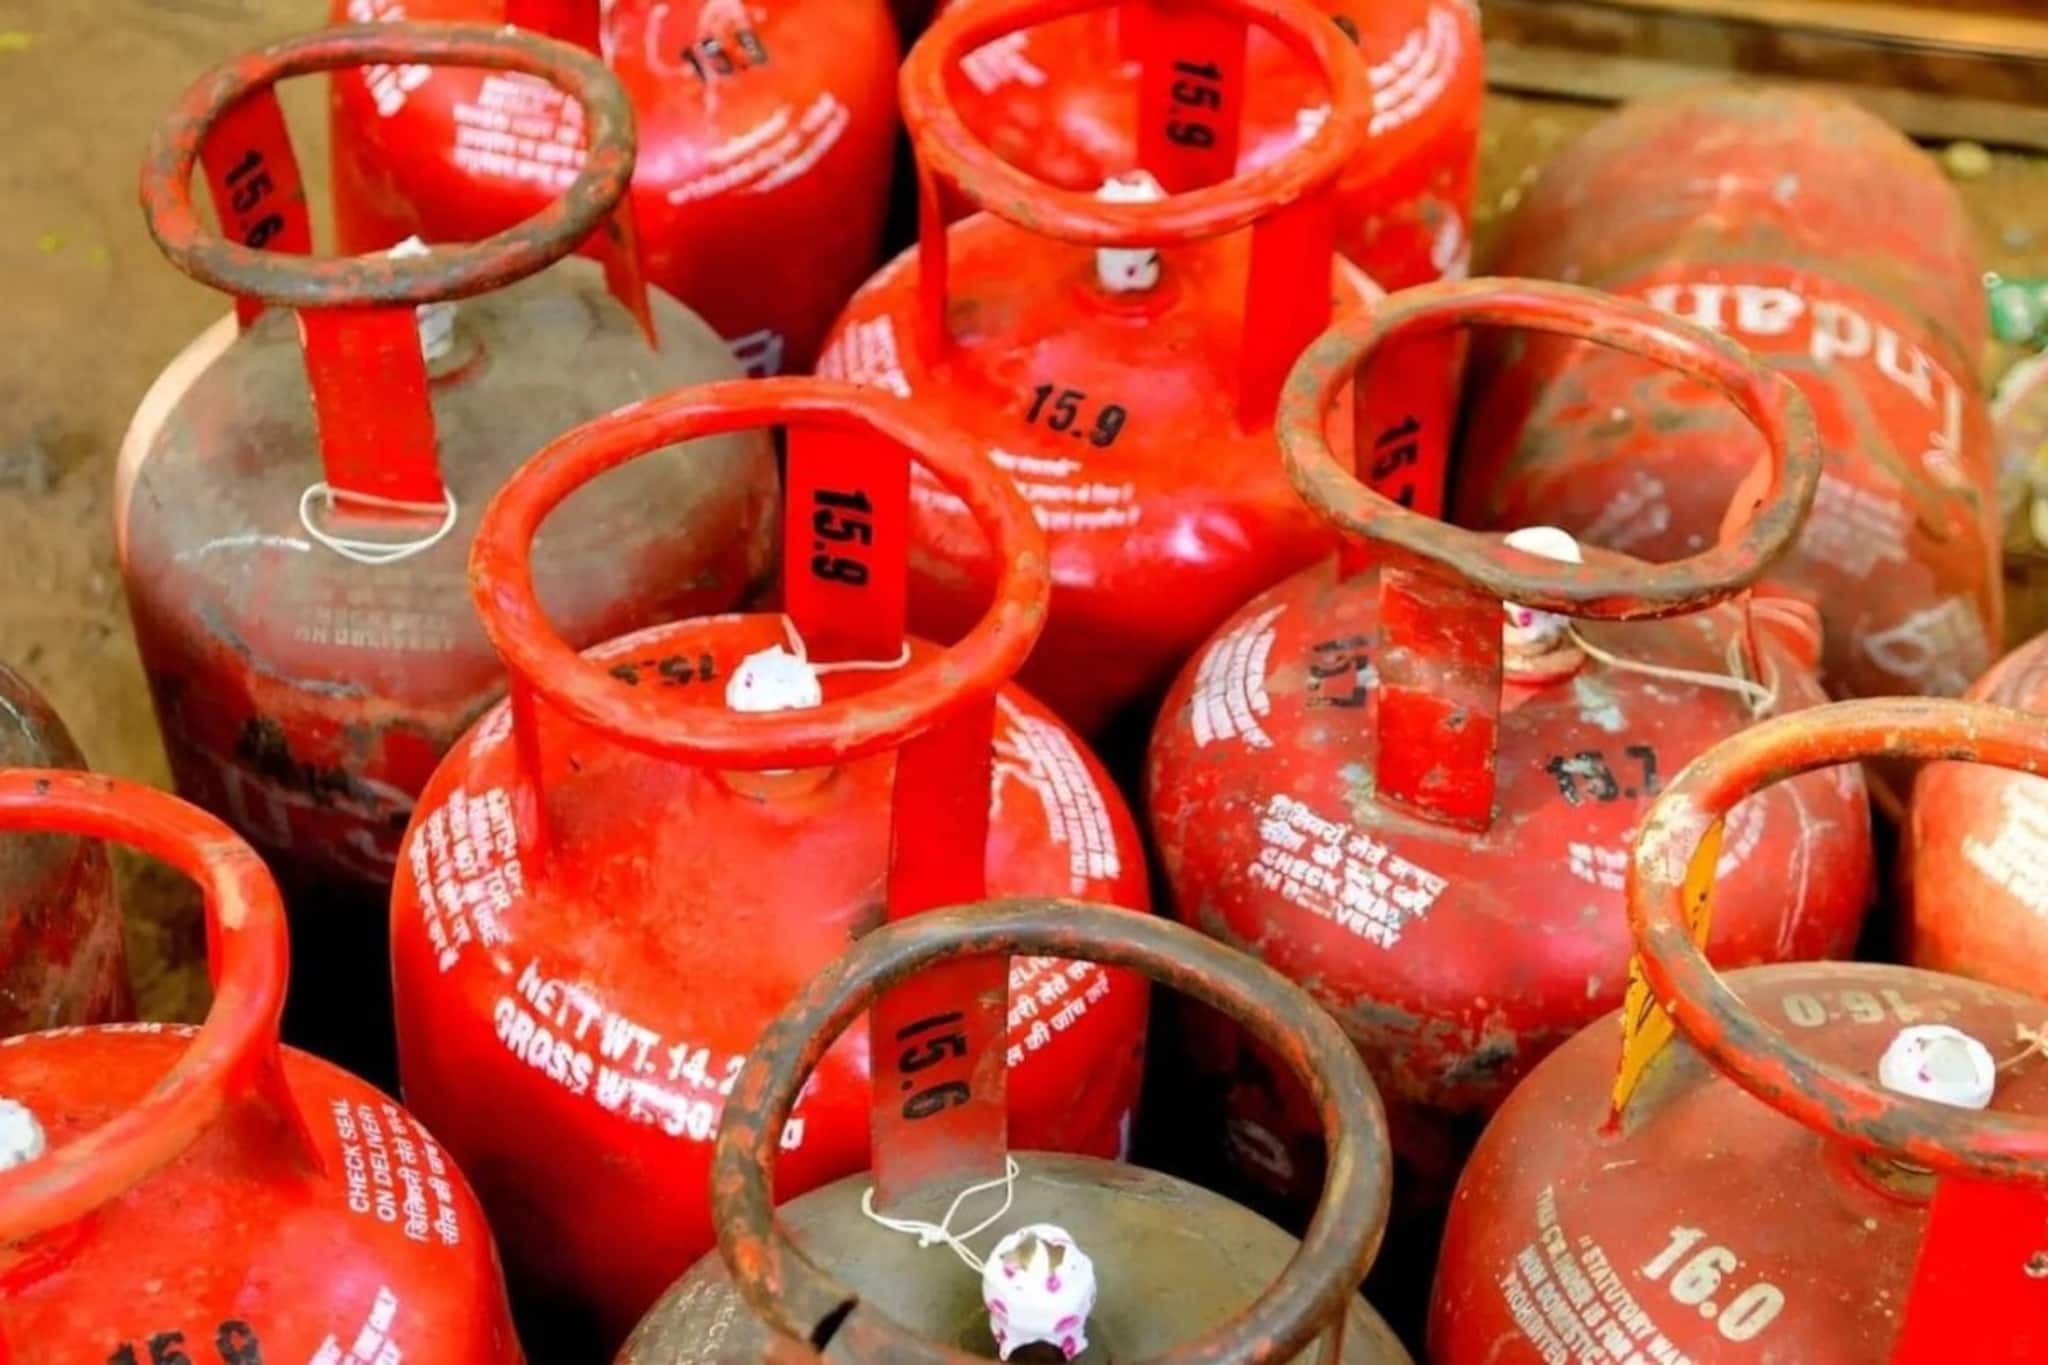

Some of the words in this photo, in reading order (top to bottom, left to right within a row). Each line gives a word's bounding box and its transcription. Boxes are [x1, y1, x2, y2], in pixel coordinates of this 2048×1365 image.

[1165, 60, 1222, 149] 15.9
[225, 150, 285, 248] 15.6
[1025, 384, 1127, 447] 15.9
[812, 488, 872, 587] 15.9
[494, 997, 594, 1096] GROSS
[517, 957, 603, 1041] NETT
[599, 1013, 662, 1075] WT.
[896, 1011, 971, 1120] 15.6
[332, 1098, 358, 1142] SEAL
[343, 1141, 370, 1214] CHECK
[375, 1188, 398, 1223] ON
[1640, 1225, 1786, 1342] 16.0
